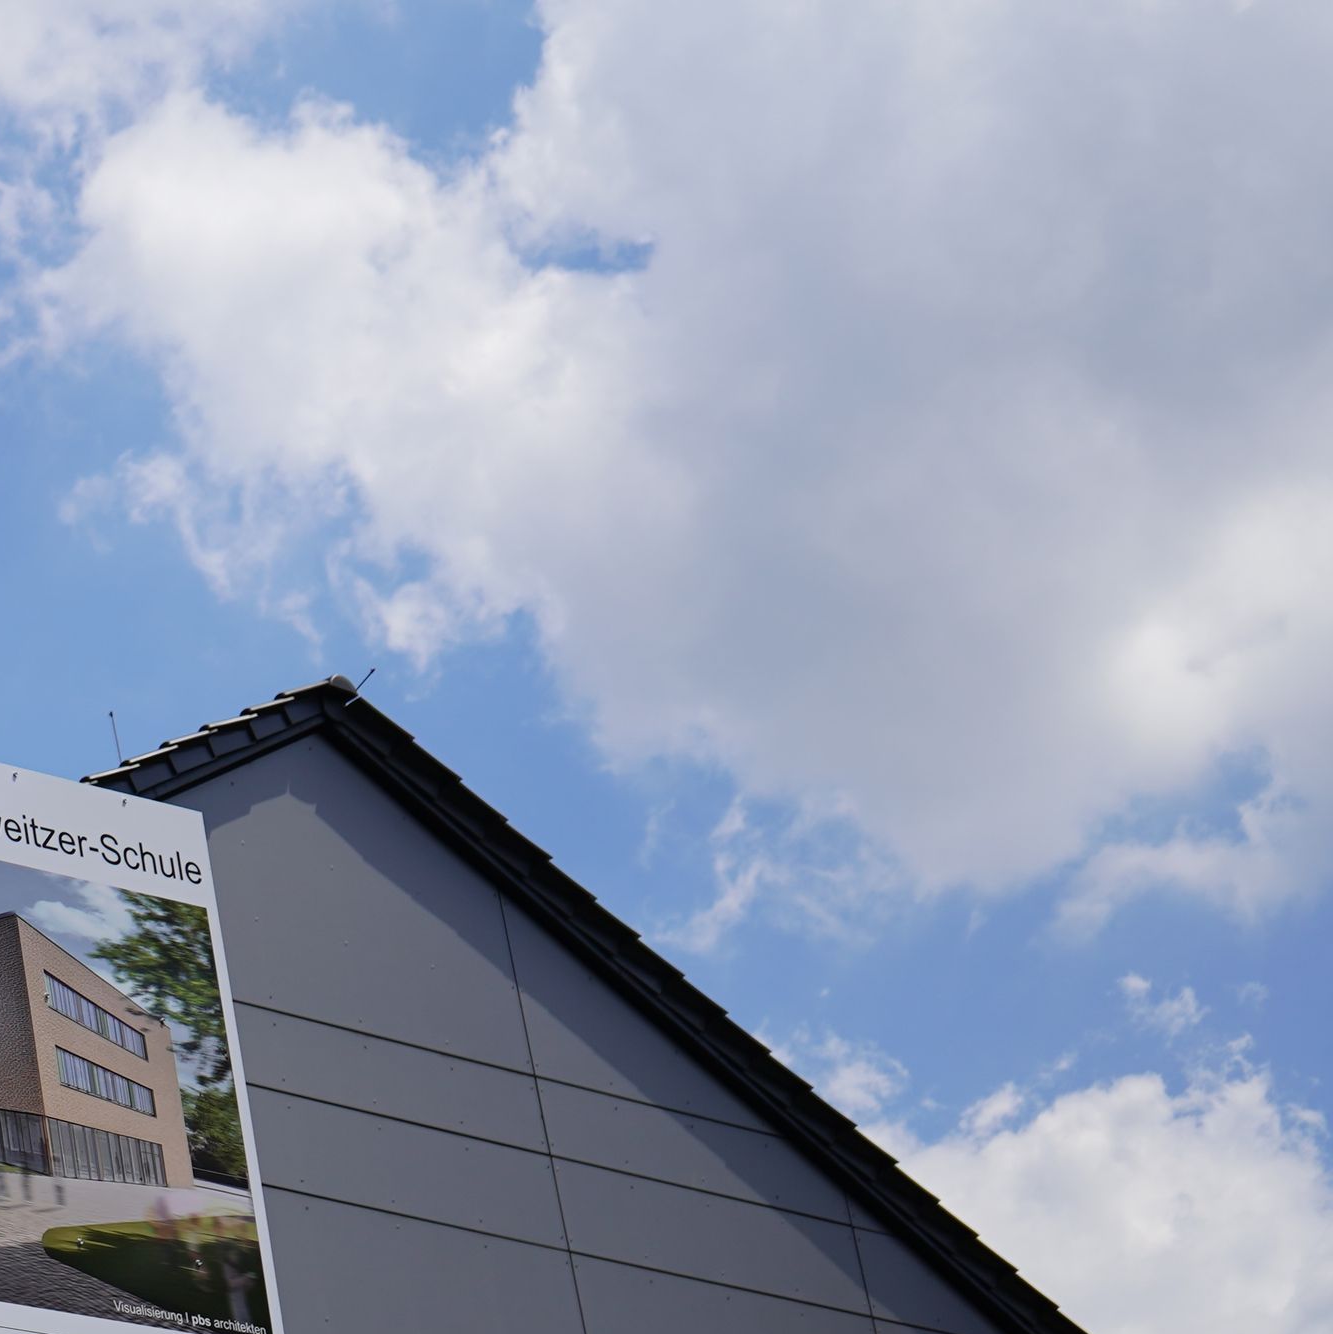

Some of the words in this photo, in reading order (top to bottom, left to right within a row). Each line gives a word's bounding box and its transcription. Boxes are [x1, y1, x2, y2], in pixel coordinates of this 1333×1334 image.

[113, 1300, 183, 1325] Visualisierung
[192, 1314, 211, 1326] pbs
[214, 1320, 266, 1334] architekten
